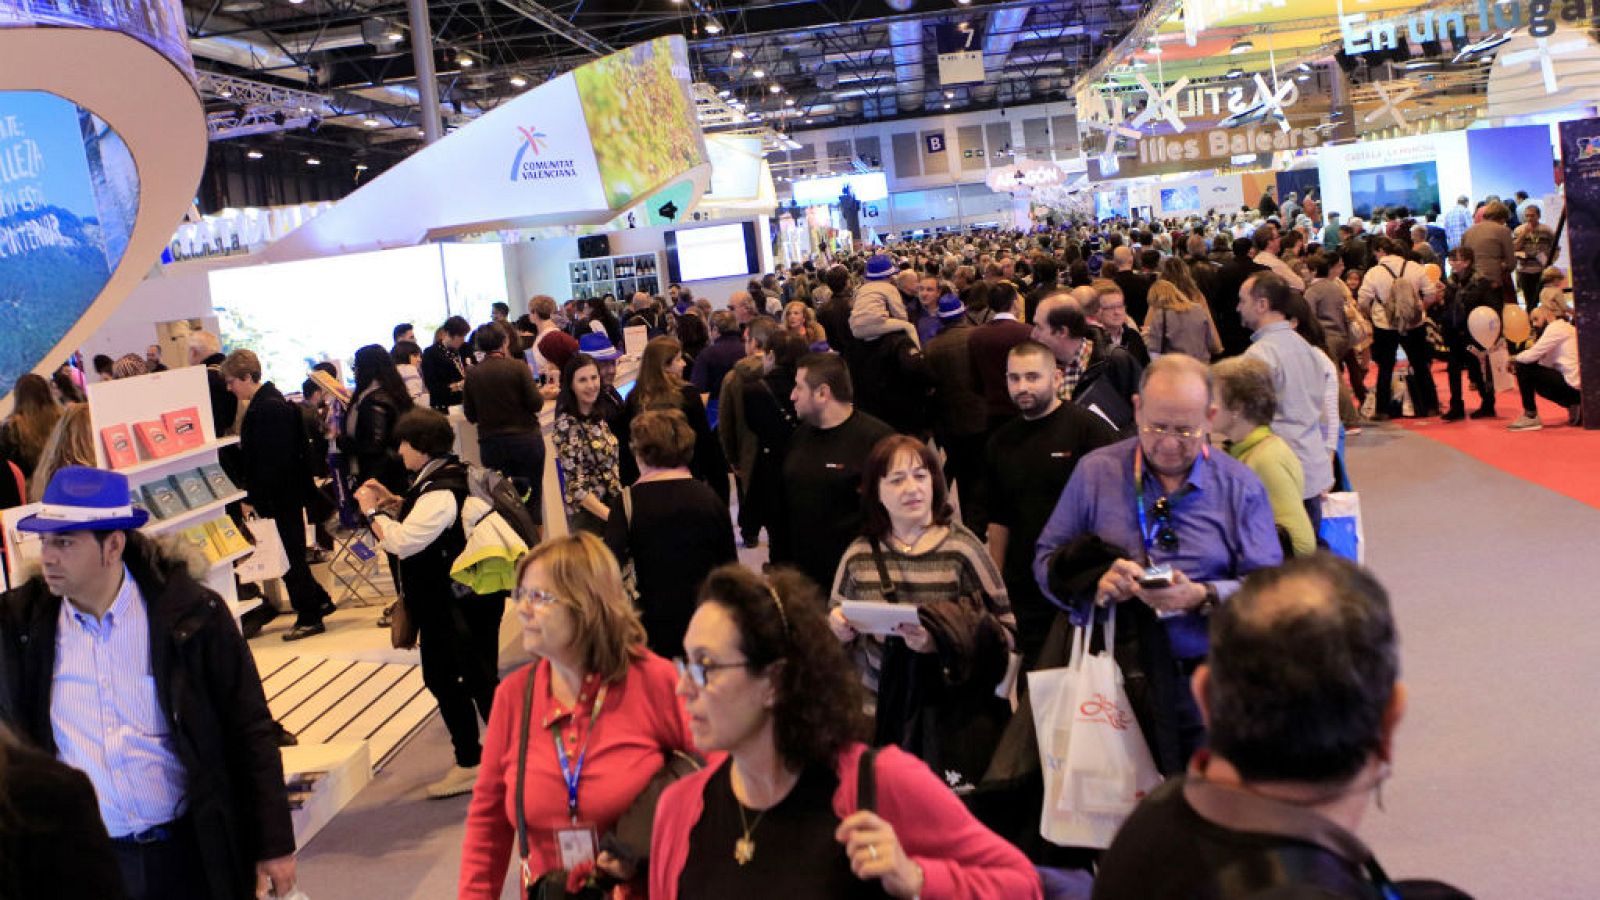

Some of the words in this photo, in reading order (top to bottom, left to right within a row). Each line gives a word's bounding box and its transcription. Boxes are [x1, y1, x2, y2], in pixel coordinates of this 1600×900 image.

[961, 28, 975, 48] 7
[1343, 13, 1398, 55] En
[1408, 10, 1466, 43] un
[931, 137, 942, 151] B
[1139, 135, 1200, 163] Illes
[1208, 126, 1318, 157] Balears
[523, 160, 575, 171] COMUNITAT
[522, 169, 577, 180] VALENCIANA
